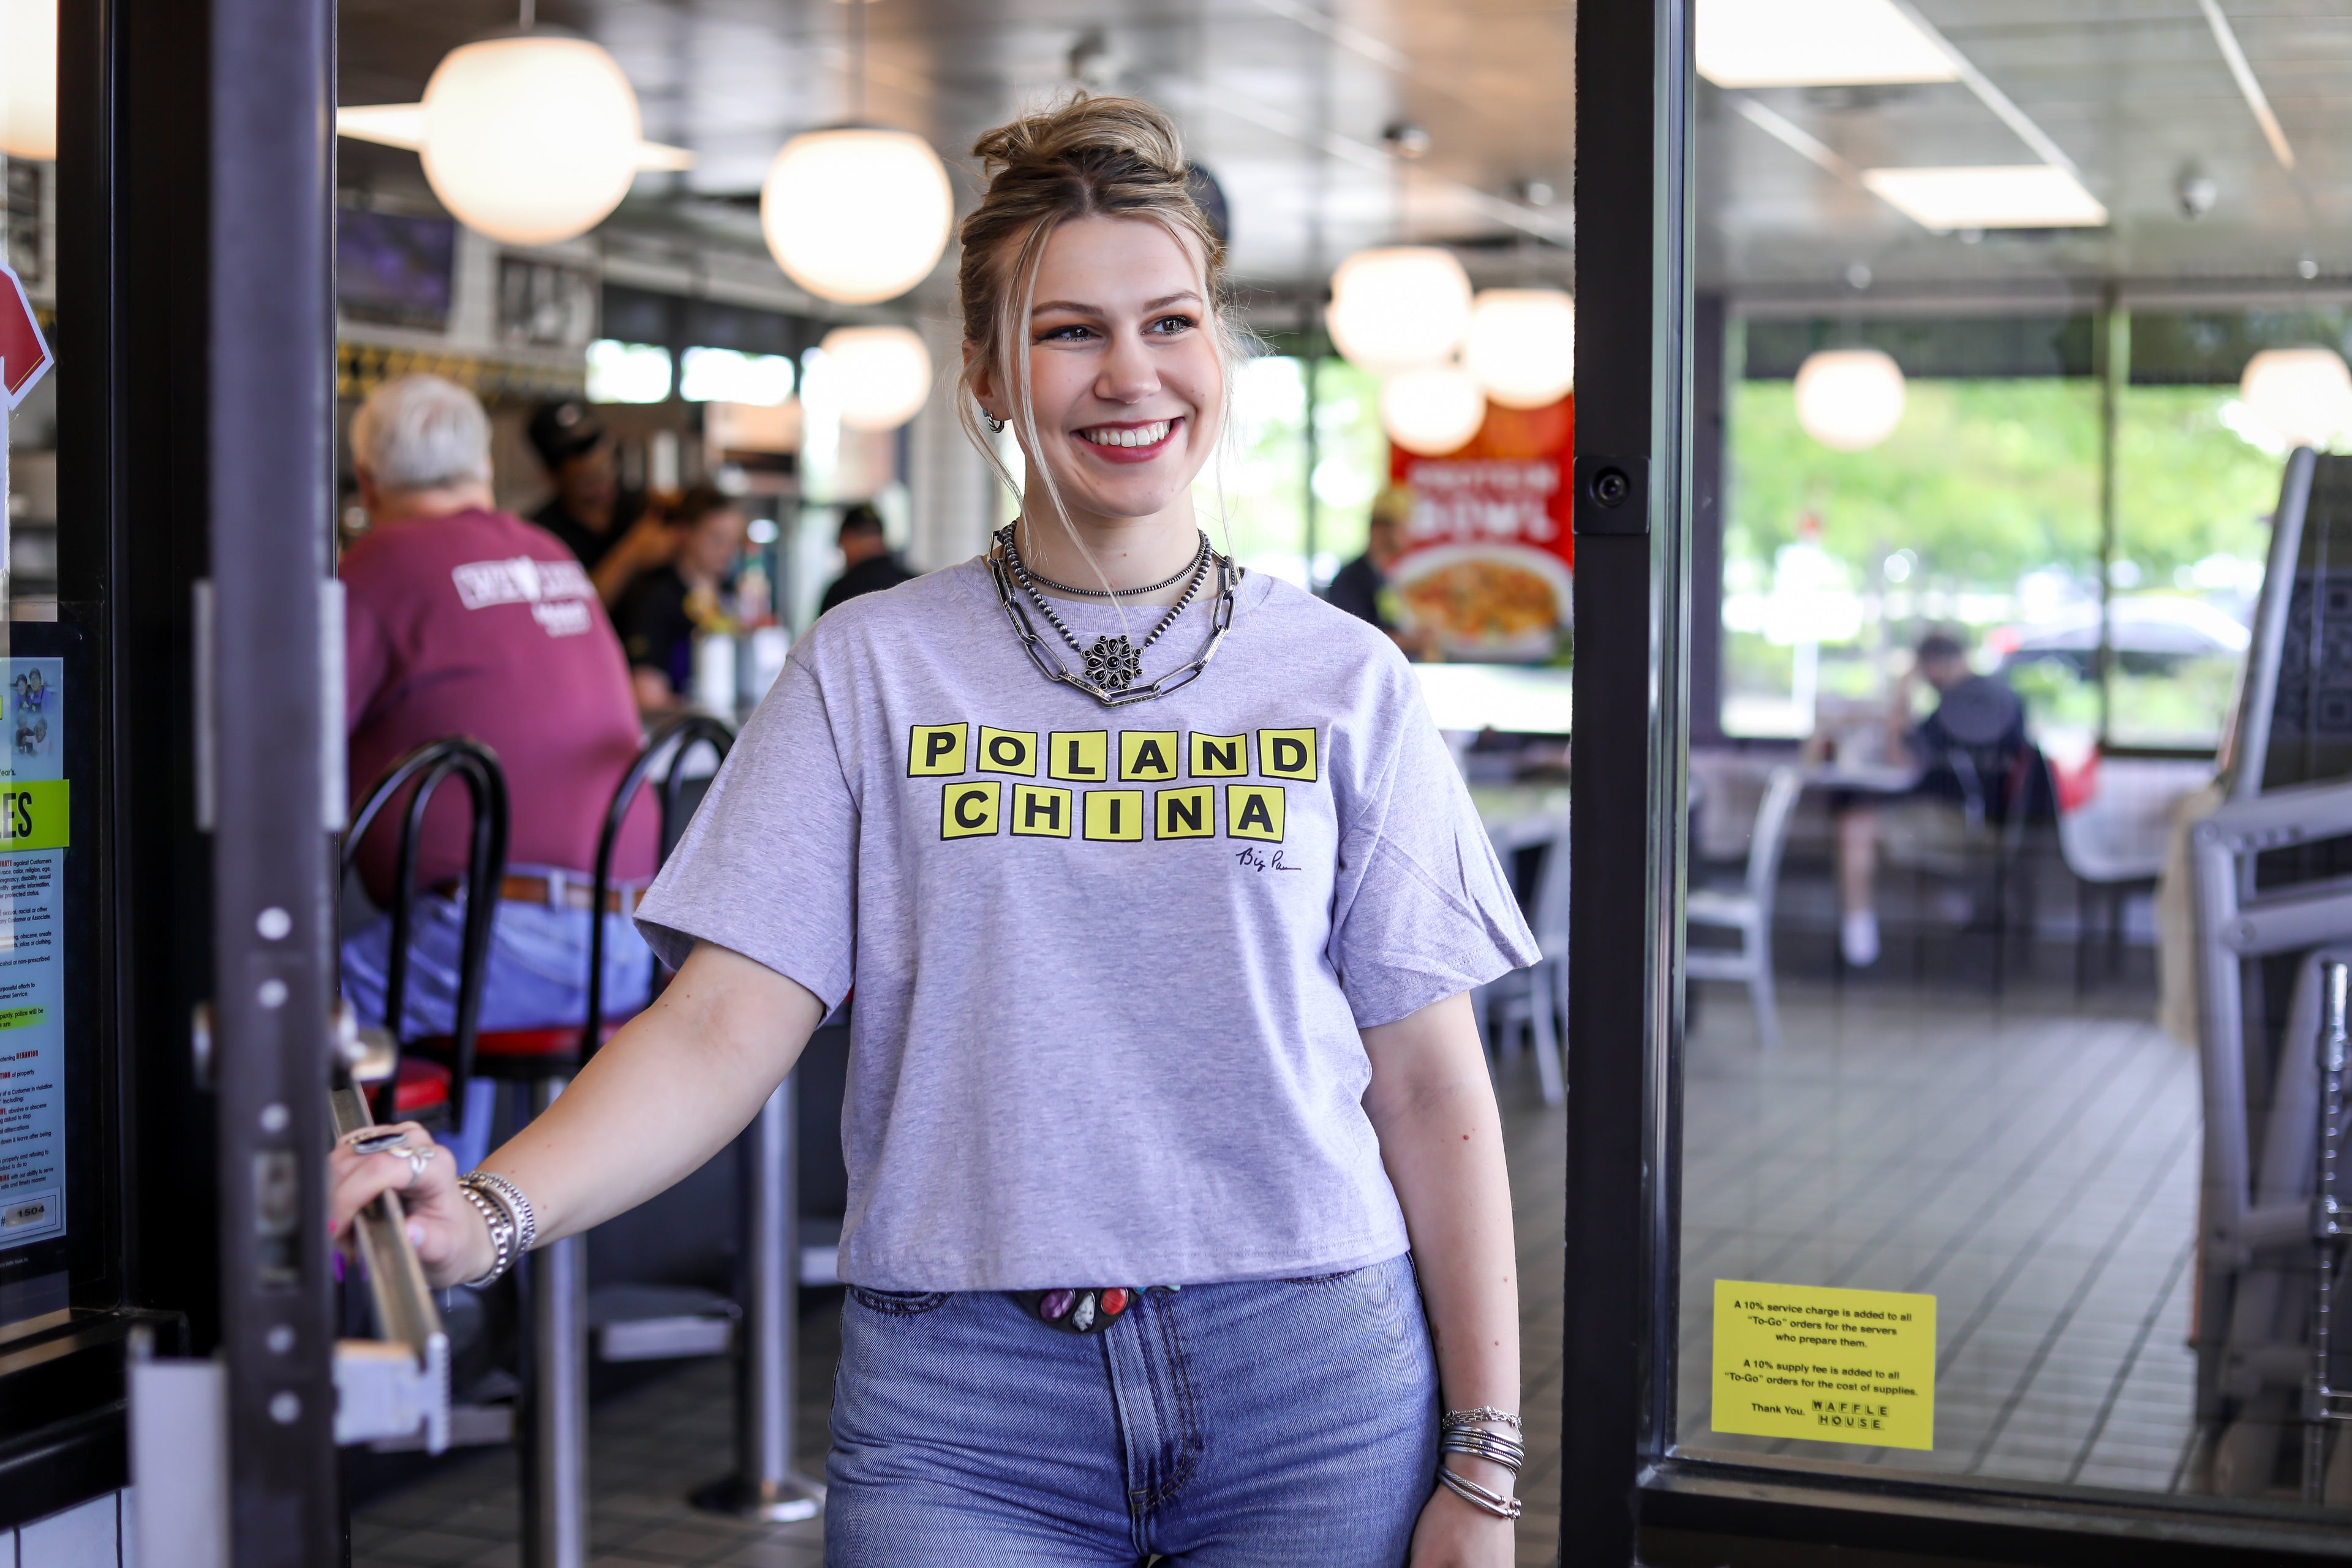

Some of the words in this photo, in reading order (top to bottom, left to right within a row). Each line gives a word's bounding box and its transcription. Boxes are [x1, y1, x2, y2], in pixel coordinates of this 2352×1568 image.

[925, 731, 1307, 774] POLAND
[954, 790, 1274, 833] CHINA
[1235, 847, 1265, 872] Big
[5, 891, 26, 899] protected
[18, 956, 50, 964] non-prescribed
[15, 1010, 28, 1019] police
[16, 1050, 38, 1060] BEHAVIOR
[17, 1069, 34, 1078] property
[2, 1155, 19, 1164] property
[17, 1205, 45, 1218] 1504
[1745, 1302, 1764, 1310] 10%
[1768, 1305, 1802, 1313] service
[1806, 1306, 1839, 1317] charge
[1854, 1310, 1884, 1320] added
[1748, 1316, 1787, 1326] "To-Go"
[1790, 1320, 1822, 1330] orders
[1825, 1322, 1839, 1330] for
[1842, 1323, 1857, 1332] the
[1861, 1326, 1897, 1335] servers
[1776, 1333, 1796, 1342] who
[1800, 1336, 1837, 1346] prepare
[1841, 1338, 1867, 1348] them.
[1754, 1360, 1773, 1369] 10%
[1776, 1363, 1809, 1374] supply
[1812, 1365, 1827, 1373] fee
[1842, 1368, 1872, 1378] added
[1725, 1372, 1763, 1383] "To-Go"
[1766, 1376, 1798, 1386] orders
[1801, 1379, 1815, 1388] for
[1818, 1381, 1833, 1389] the
[1837, 1382, 1858, 1391] cost
[1861, 1384, 1871, 1392] of
[1874, 1385, 1918, 1396] supplies.
[1752, 1403, 1781, 1414] Thank
[1785, 1405, 1805, 1415] You.
[1813, 1400, 1888, 1415] WAFFLE
[1819, 1415, 1881, 1429] HOUSE
